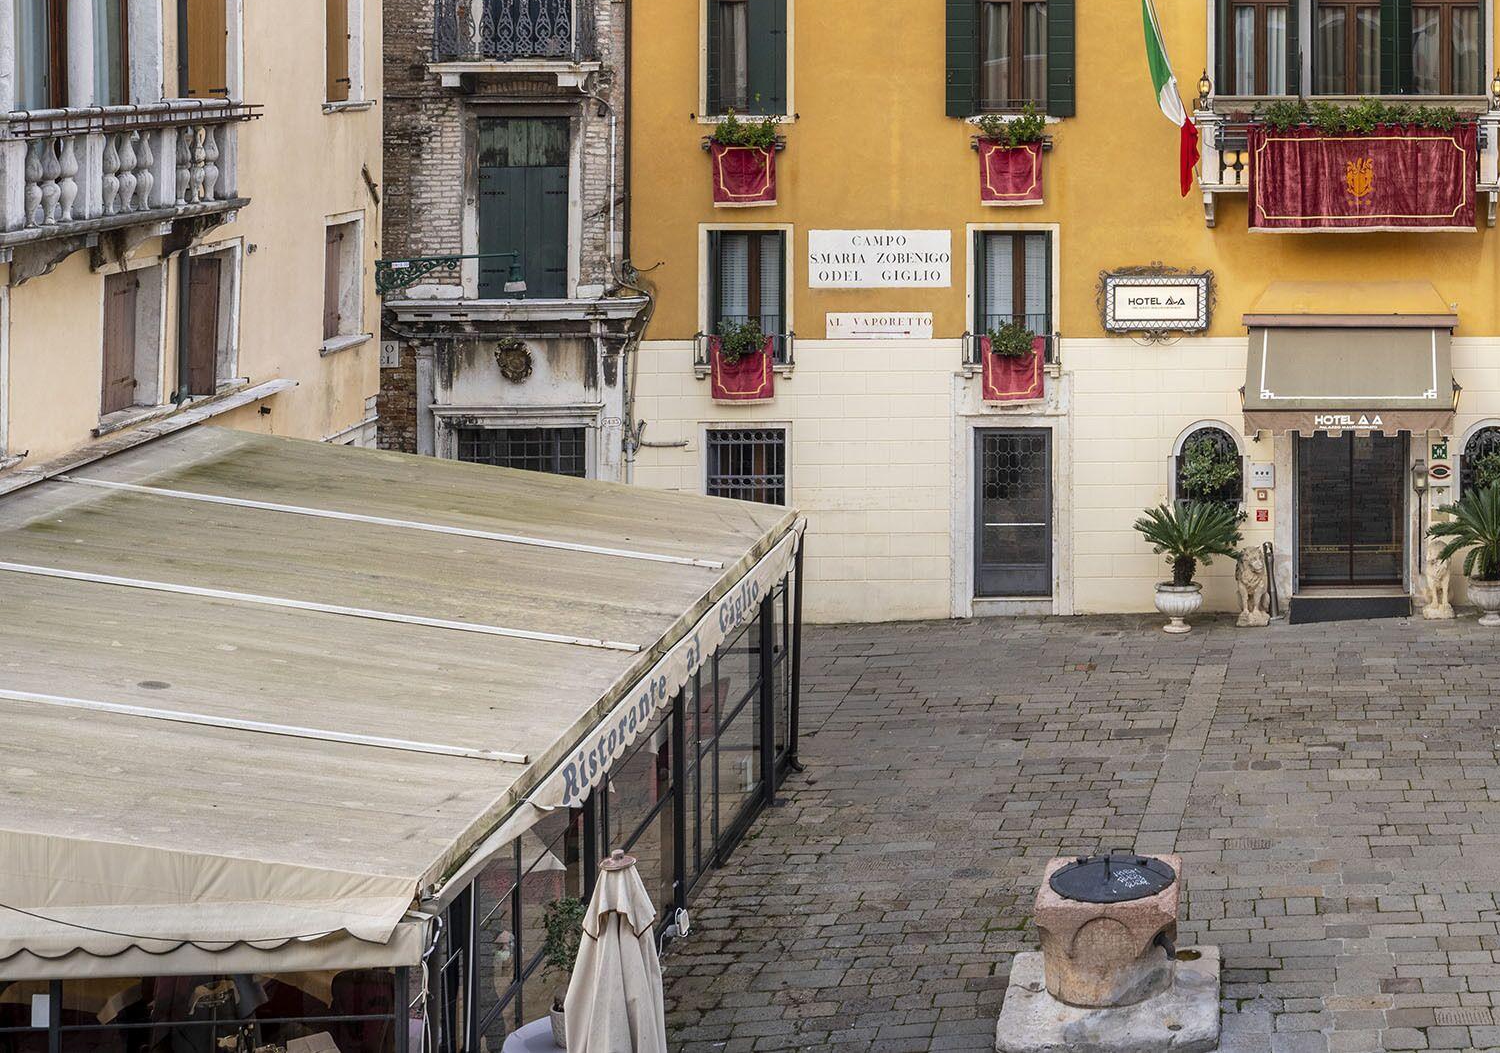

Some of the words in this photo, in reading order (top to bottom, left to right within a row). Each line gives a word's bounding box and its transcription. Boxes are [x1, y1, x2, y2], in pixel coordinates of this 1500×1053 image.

[851, 235, 907, 246] CAMPO
[876, 252, 950, 264] ZOBENIGO
[881, 270, 941, 282] GIGLIO
[1128, 297, 1162, 305] HOTEL
[828, 317, 843, 327] AL
[853, 317, 933, 327] VAPORETTO
[1314, 414, 1355, 425] HOTEL
[561, 674, 668, 805] Ristorante
[686, 633, 701, 671] al
[718, 578, 759, 634] Giglio
